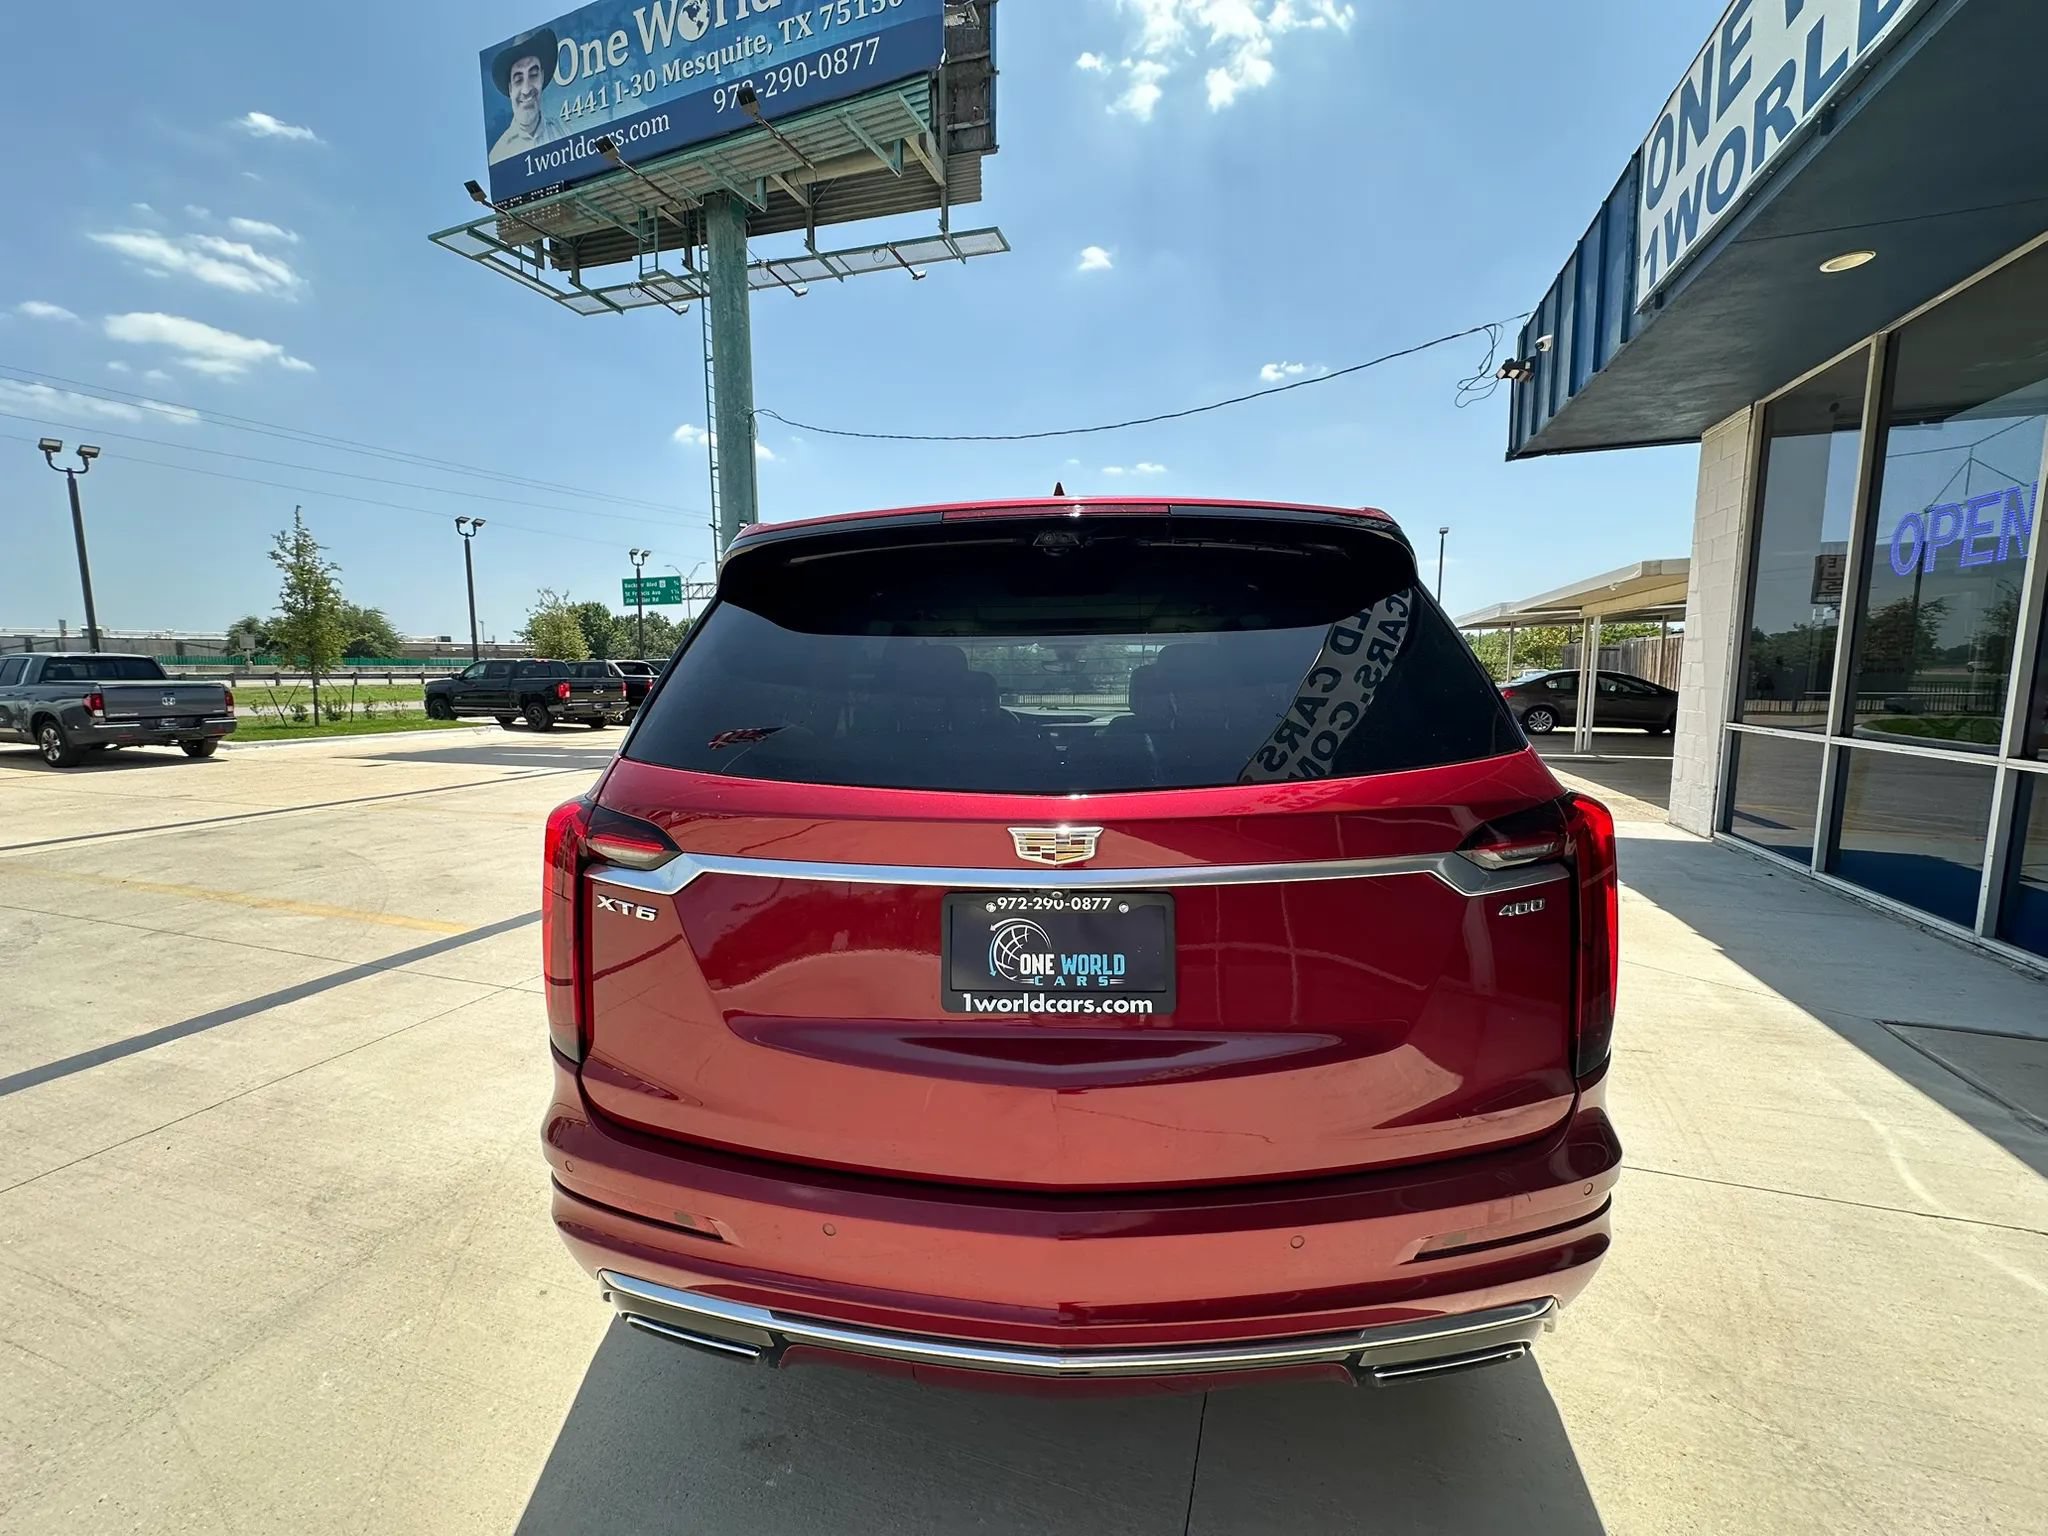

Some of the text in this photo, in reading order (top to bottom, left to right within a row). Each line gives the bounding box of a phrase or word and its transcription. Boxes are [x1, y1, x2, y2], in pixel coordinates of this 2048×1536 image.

[553, 30, 629, 86] One
[560, 85, 609, 121] 4441
[615, 69, 656, 104] I-30
[662, 34, 773, 87] Mesquite,
[778, 11, 814, 44] TX
[1646, 0, 1753, 210] ONE
[524, 113, 670, 176] 1worldcrs.com
[1890, 481, 2039, 576] OPEN
[597, 895, 657, 921] XT6
[997, 897, 1112, 910] 972-290-0877
[1499, 898, 1545, 916] 400
[1020, 953, 1125, 975] ONE WORLD
[1034, 975, 1108, 986] CARS
[963, 993, 1153, 1013] 1worldcars.com
